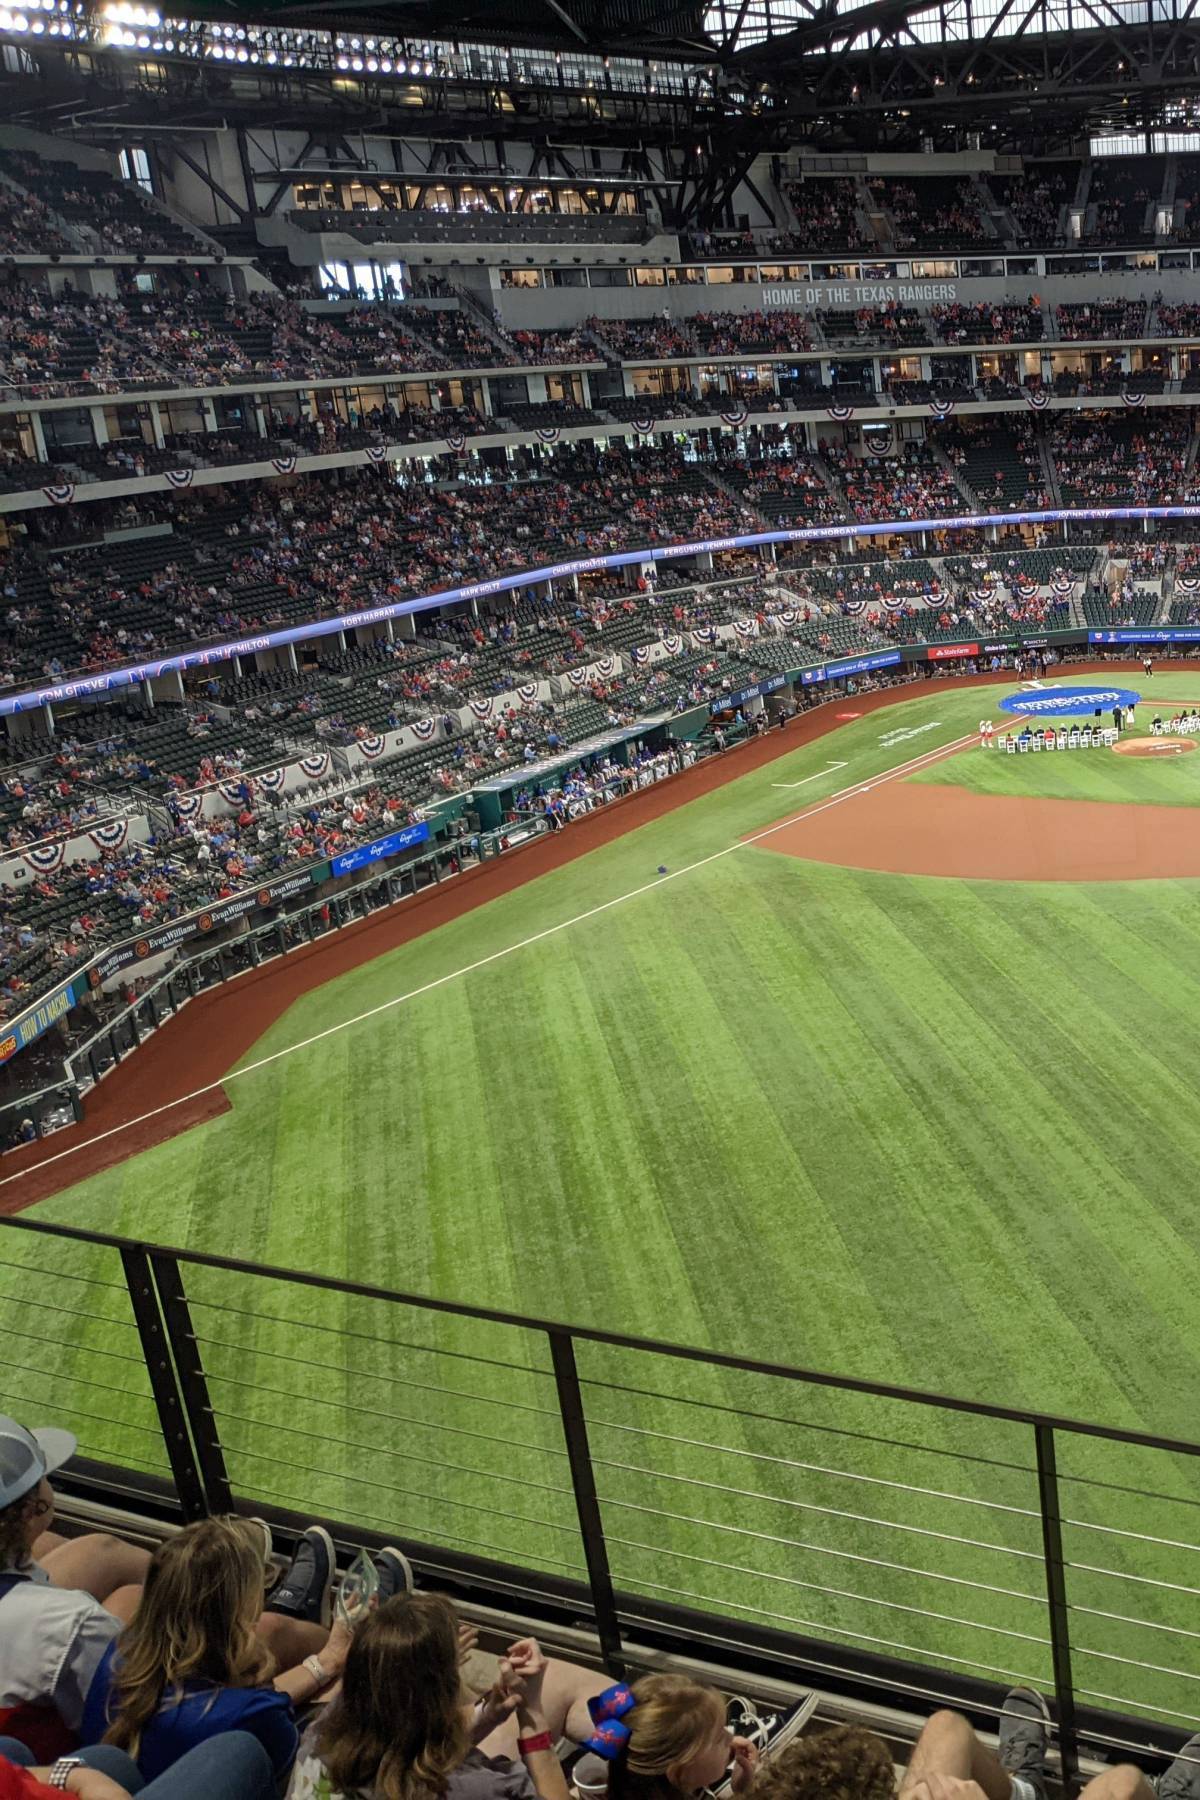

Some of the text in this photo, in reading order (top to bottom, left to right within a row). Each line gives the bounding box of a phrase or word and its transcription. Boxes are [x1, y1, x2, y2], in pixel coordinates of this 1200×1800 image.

[762, 284, 956, 305] HOME OF THE TEXAS RANGERS
[788, 527, 857, 539] CHUCK MORGAN
[664, 540, 735, 556] FERGUSON JENKINS
[460, 586, 479, 598] MARK
[342, 608, 395, 627] TOBY HARRAH
[20, 991, 72, 1044] HOW TO NACHO.
